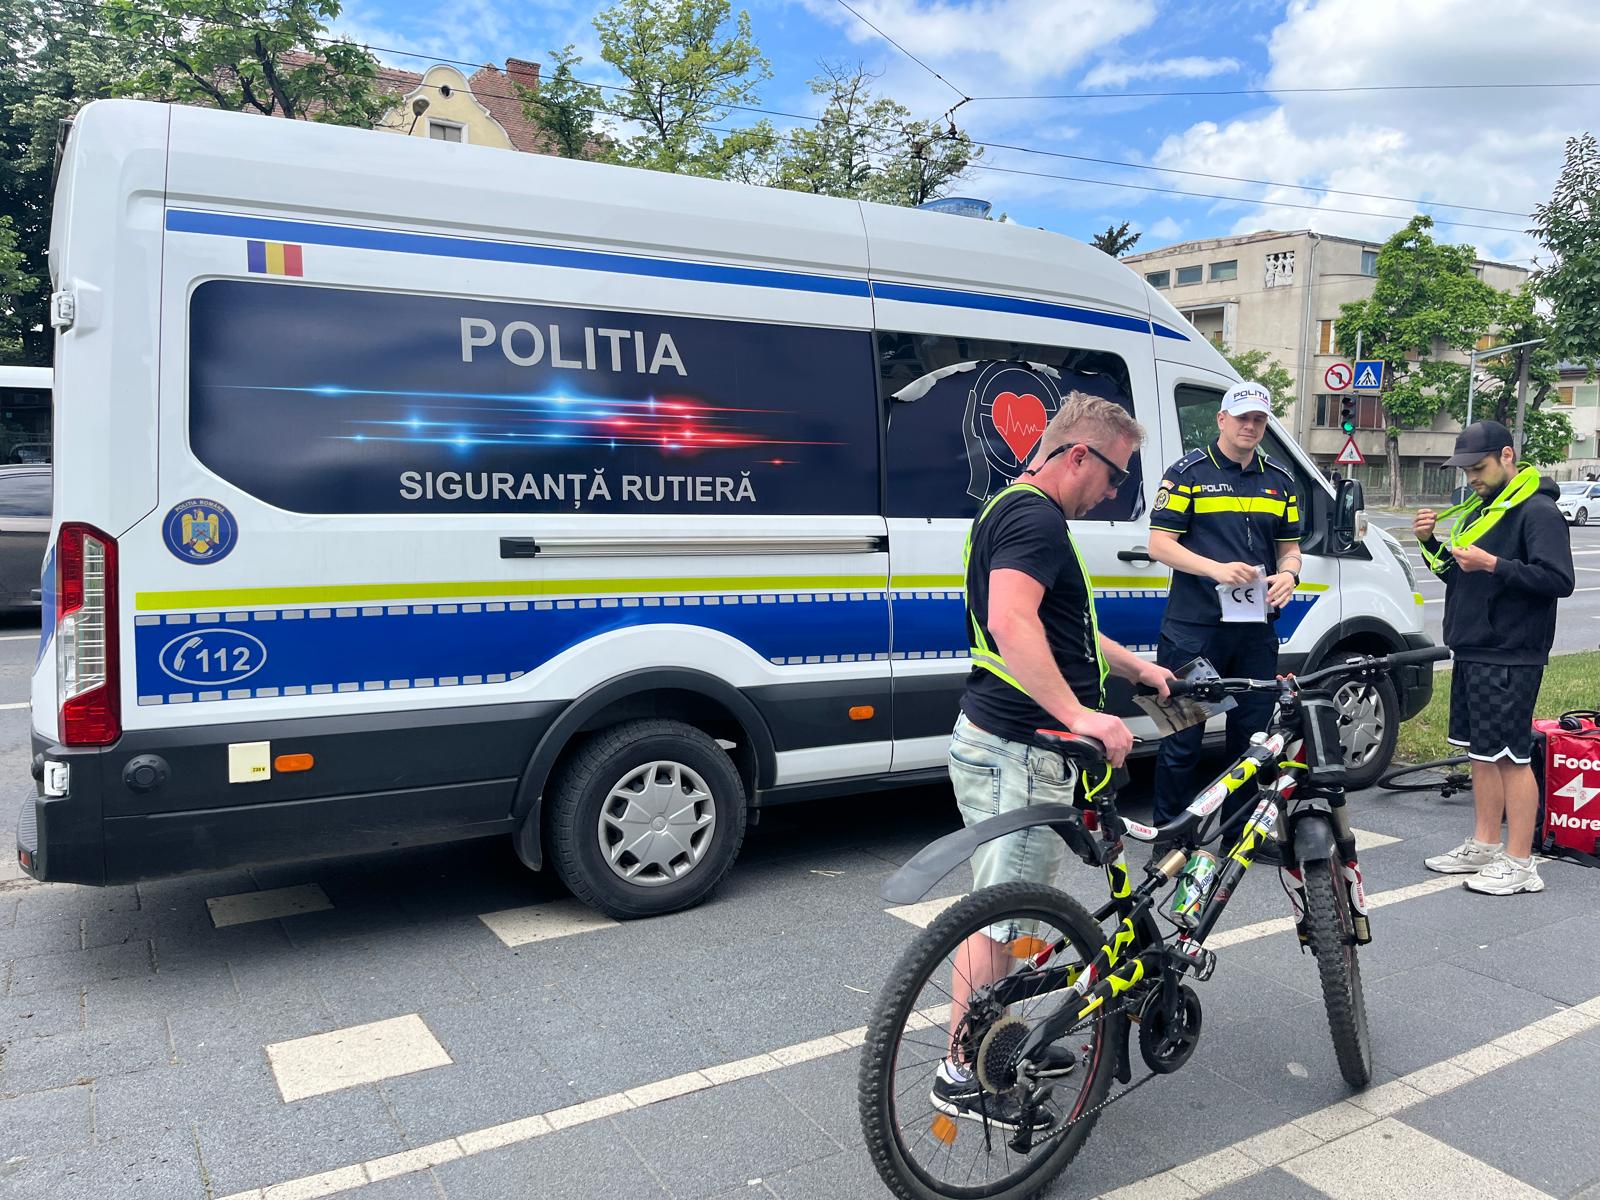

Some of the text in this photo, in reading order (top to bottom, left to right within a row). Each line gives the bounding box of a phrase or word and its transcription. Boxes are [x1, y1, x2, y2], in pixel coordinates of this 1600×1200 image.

[460, 317, 688, 376] POLITIA
[1233, 389, 1268, 401] POLITIA
[399, 467, 757, 510] SIGURANȚĂ RUTIERĂ
[1201, 483, 1234, 493] POLITIA
[1231, 587, 1255, 604] CE
[195, 646, 251, 673] 112
[1550, 812, 1600, 831] More
